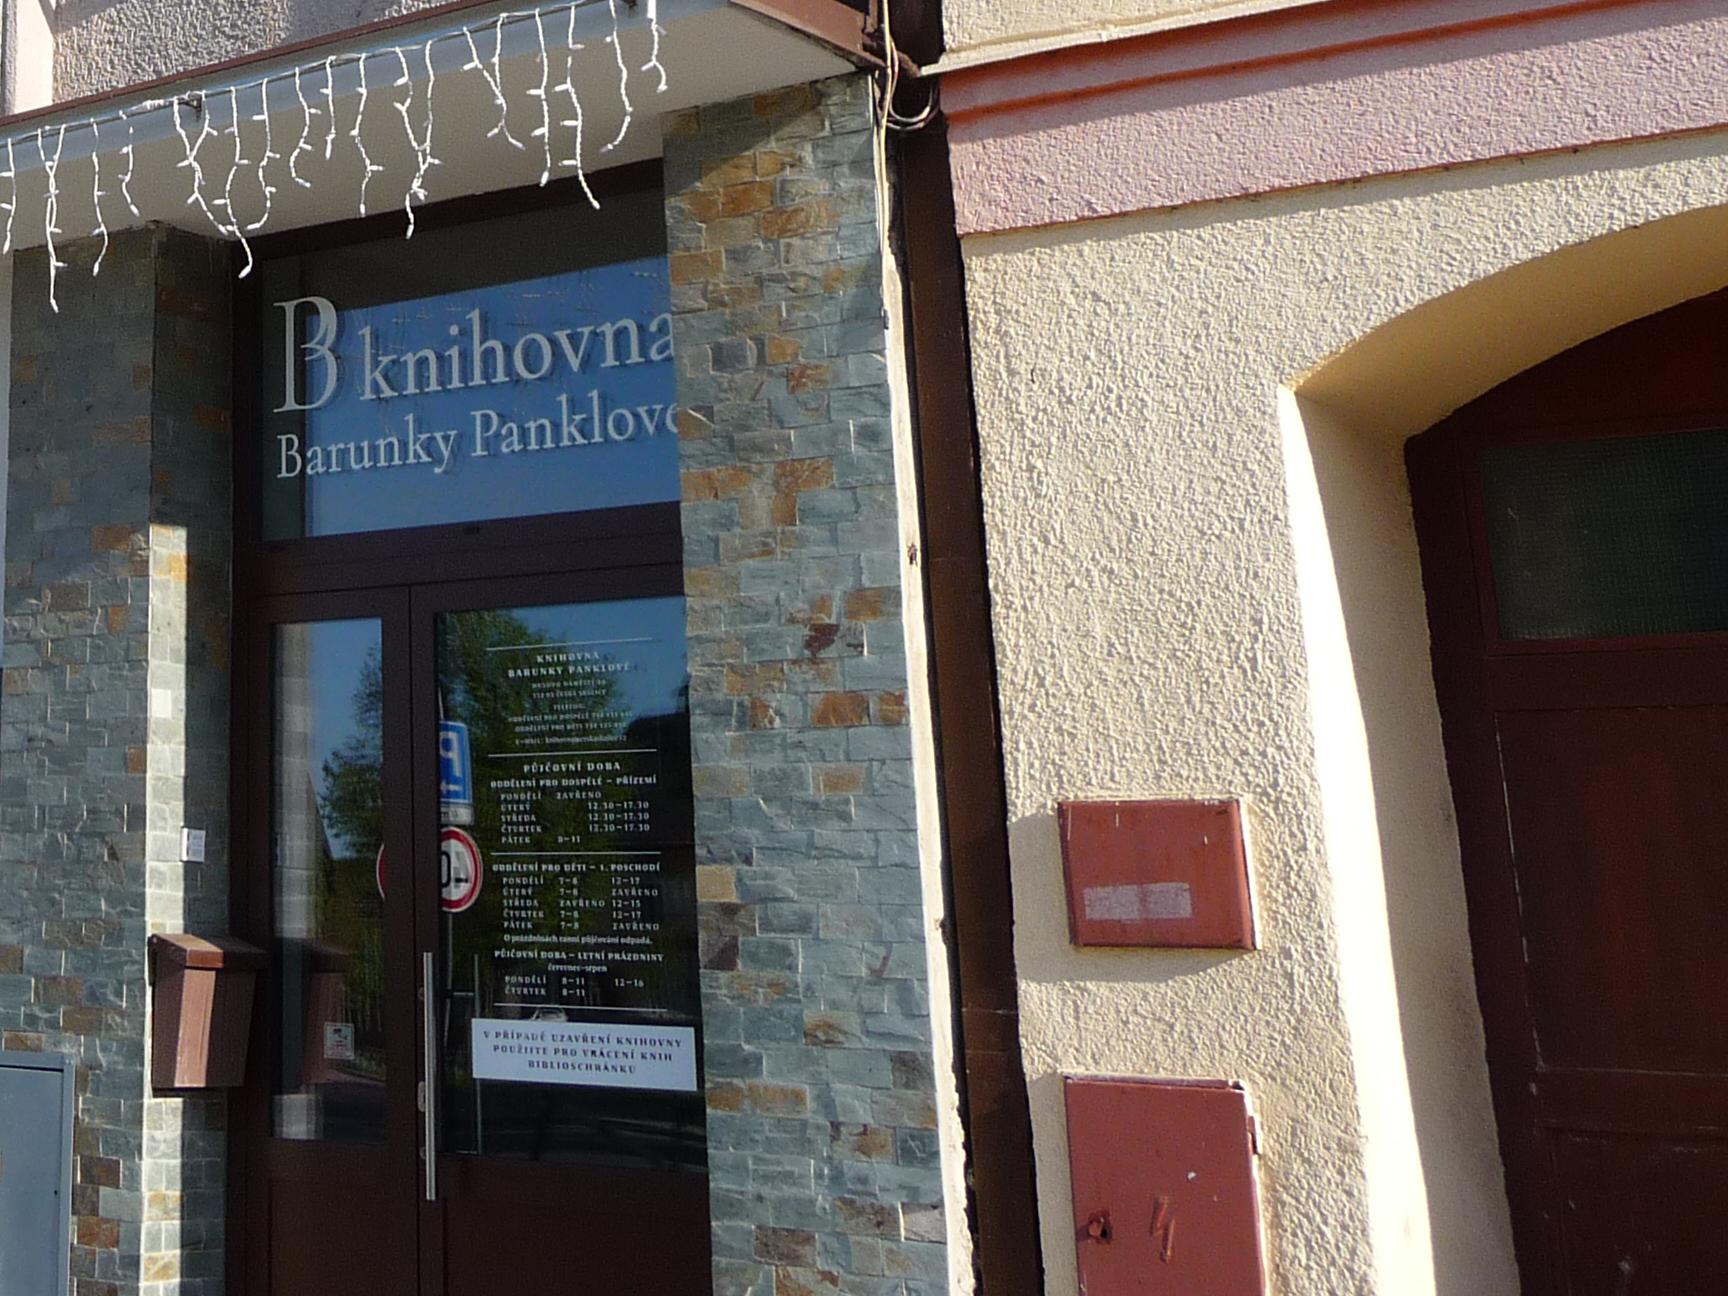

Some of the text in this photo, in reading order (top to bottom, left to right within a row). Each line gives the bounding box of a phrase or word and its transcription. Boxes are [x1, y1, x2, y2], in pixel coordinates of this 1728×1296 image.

[273, 296, 337, 413] B
[277, 413, 457, 478] Barunky
[536, 651, 600, 663] KNIHOVNA
[507, 666, 563, 678] BARUNKY
[523, 761, 621, 774] PŮJČOVNÍ DOBA
[539, 778, 559, 787] PRO
[541, 863, 561, 872] PRO
[610, 861, 661, 872] POSCHODÍ
[541, 950, 567, 960] DOBA
[607, 950, 664, 962] PRÁZDNINY
[483, 1031, 490, 1039] V
[552, 1032, 610, 1044] UZAVŘENÍ
[616, 1035, 682, 1048] KNIHOVNY
[554, 1047, 577, 1057] PRO
[583, 1047, 635, 1060] VRÁCENÍ
[641, 1051, 672, 1062] KNIH
[528, 1059, 636, 1074] BIBLIOSCHRÁNKU
